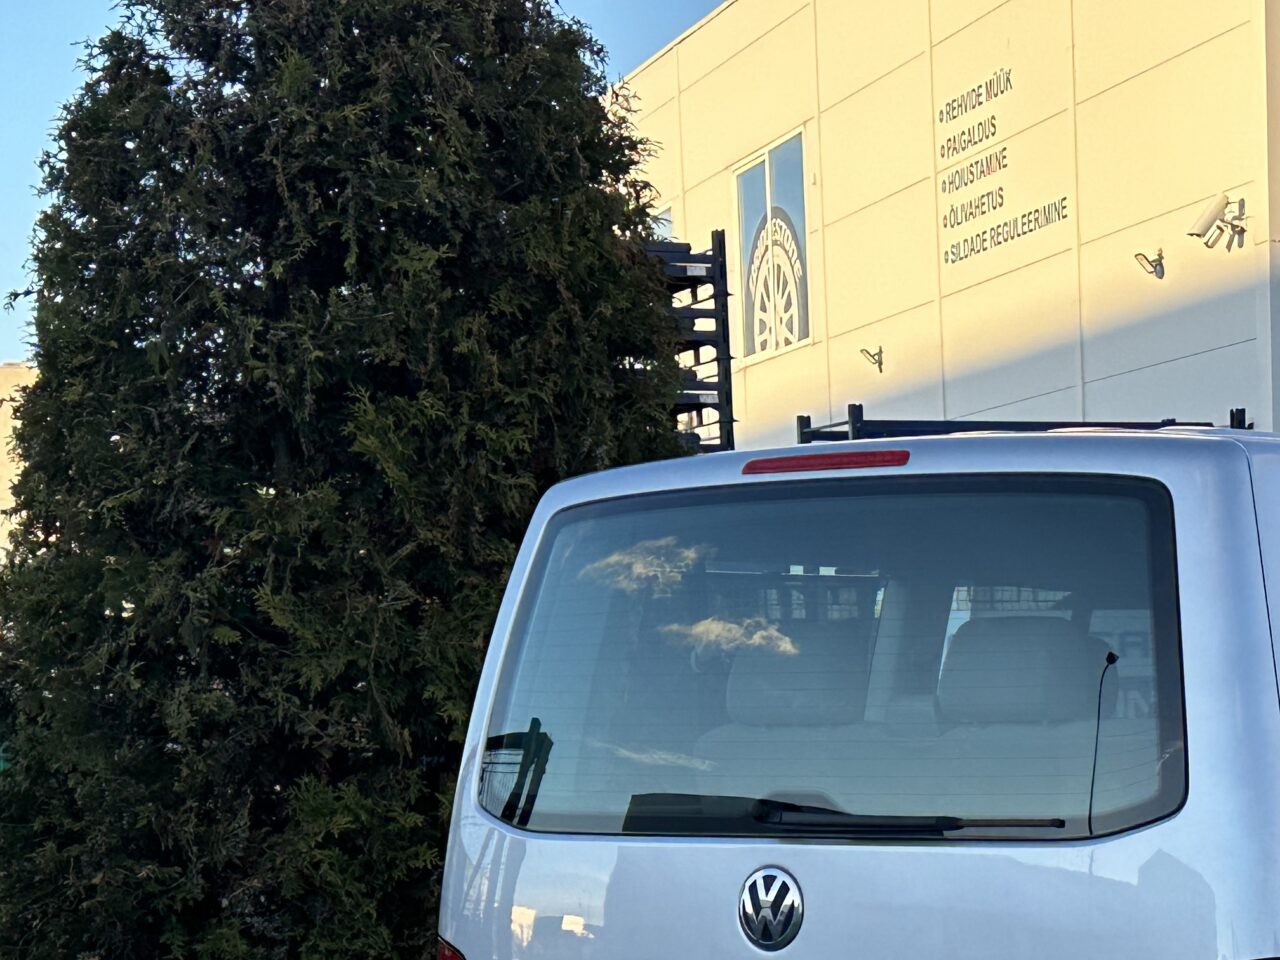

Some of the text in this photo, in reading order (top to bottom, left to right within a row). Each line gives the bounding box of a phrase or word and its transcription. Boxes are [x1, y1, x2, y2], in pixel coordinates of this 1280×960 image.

[945, 68, 1013, 124] REHVIDE MÜÜK
[946, 114, 997, 159] PAIGALDUS
[947, 146, 1008, 194] HOIUSTAMINE
[950, 196, 1068, 264] SILDADE REGULEERIMINE
